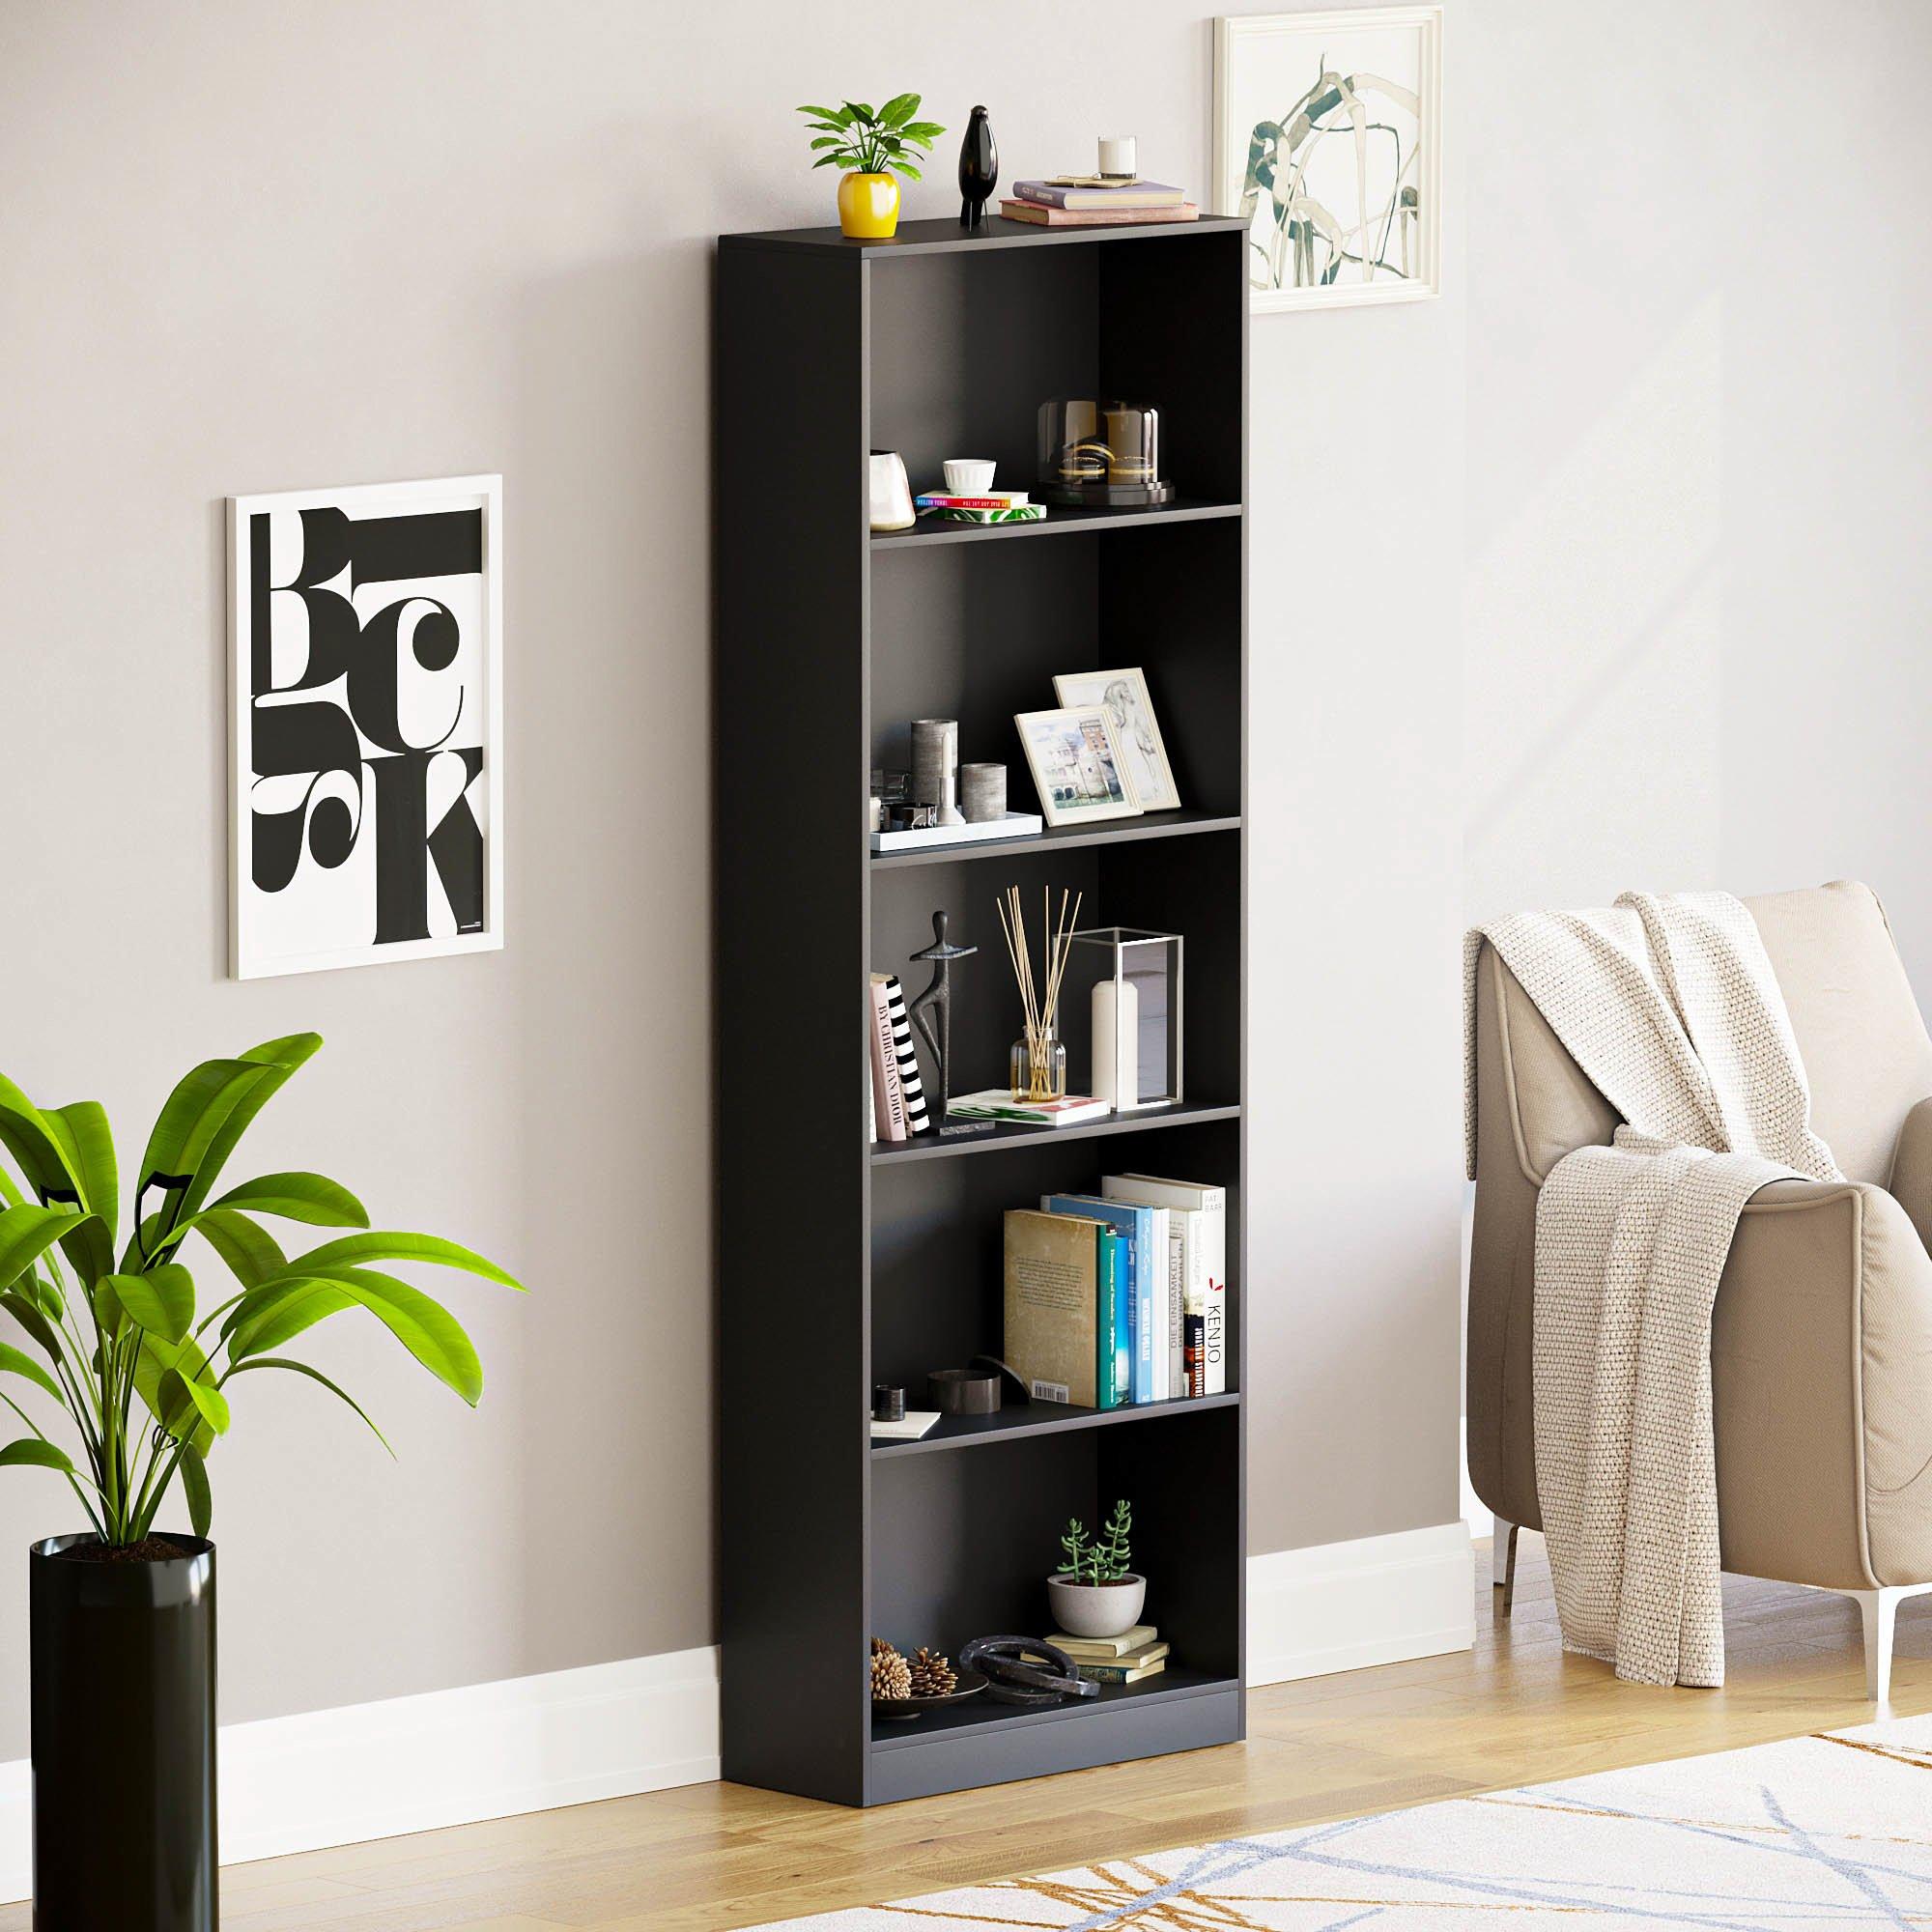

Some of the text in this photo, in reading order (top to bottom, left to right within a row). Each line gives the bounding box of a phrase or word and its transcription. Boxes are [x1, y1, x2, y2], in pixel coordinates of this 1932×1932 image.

[878, 1005, 902, 1125] BY CHRISTIAN DIOR
[1208, 1305, 1221, 1363] KENJO
